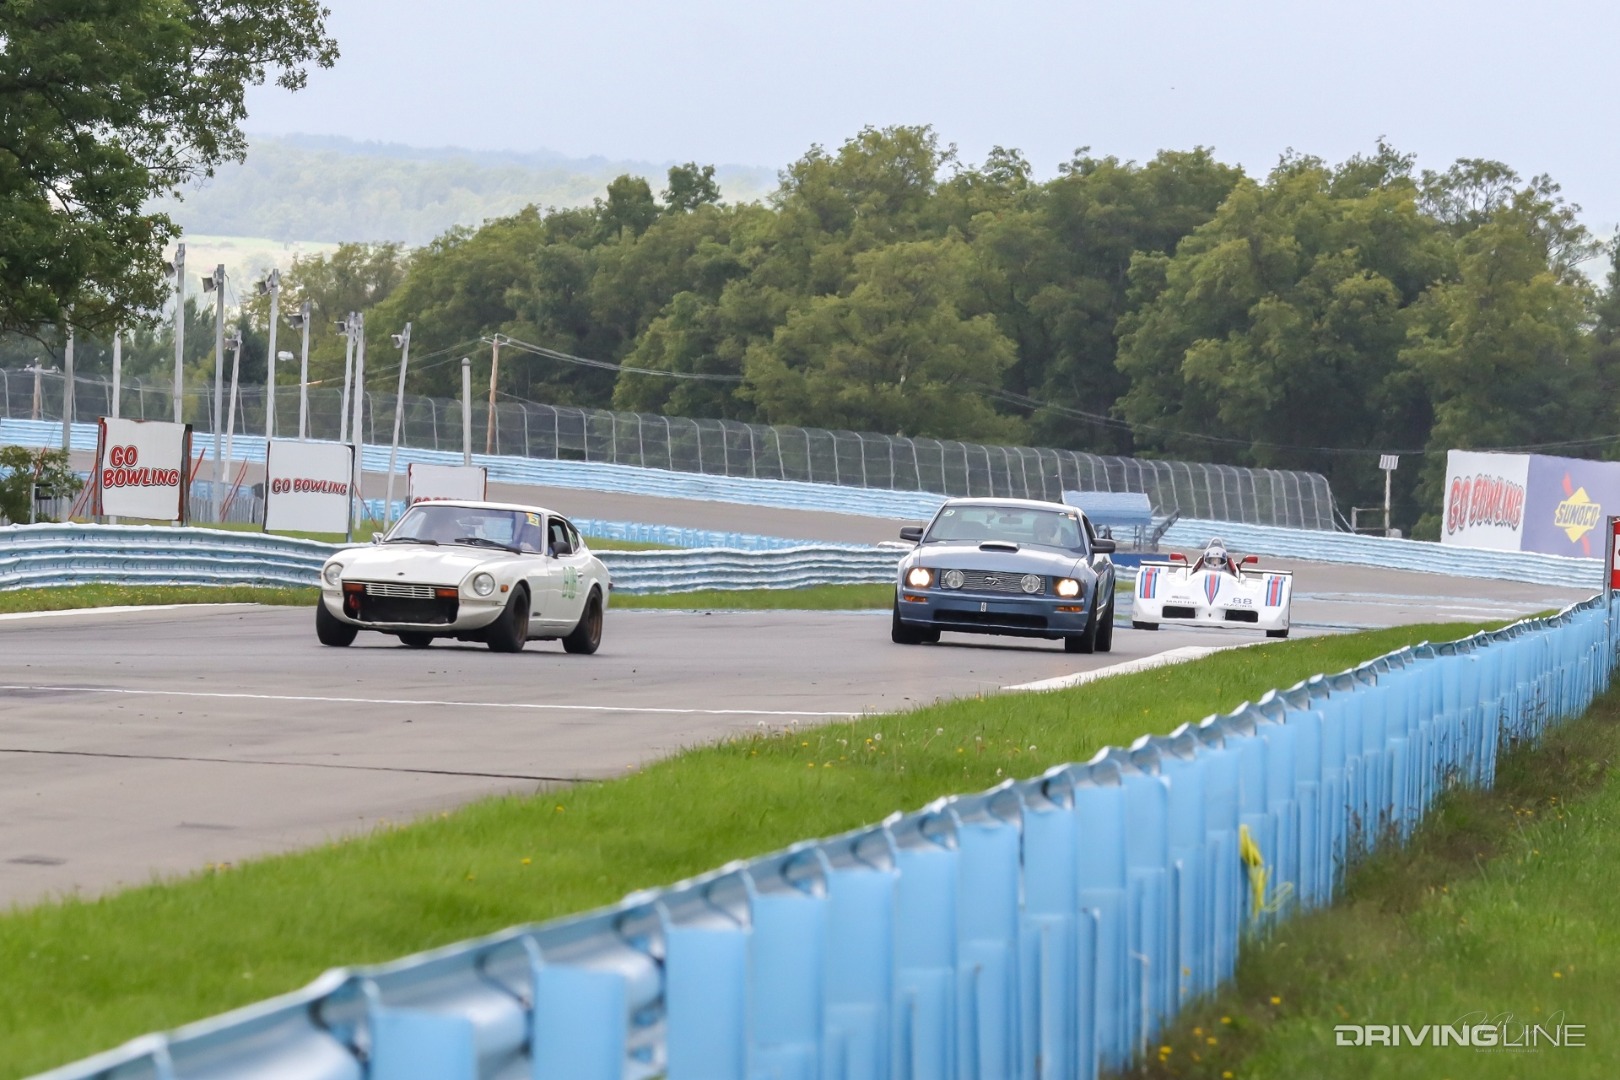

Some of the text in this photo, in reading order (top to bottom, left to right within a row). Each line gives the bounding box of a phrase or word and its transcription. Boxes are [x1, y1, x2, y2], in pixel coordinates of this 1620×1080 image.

[110, 445, 138, 467] GO
[103, 467, 179, 489] BOWLING
[272, 478, 347, 495] GO BOWLING
[1447, 473, 1524, 535] GO BOWLING
[1556, 504, 1599, 527] SUNOCO
[1233, 597, 1252, 605] 88
